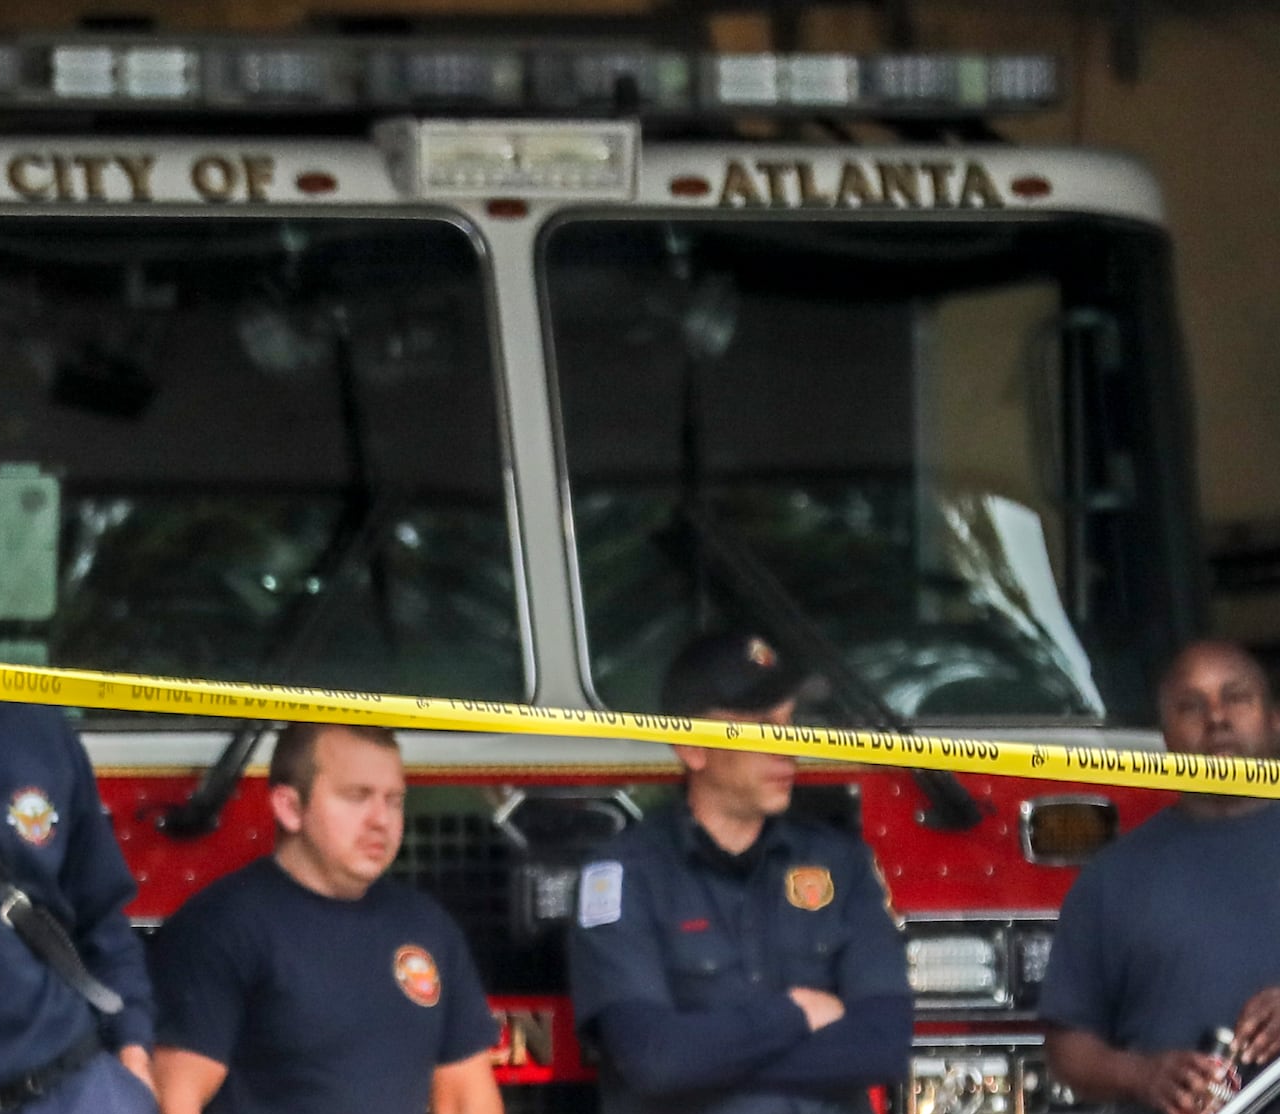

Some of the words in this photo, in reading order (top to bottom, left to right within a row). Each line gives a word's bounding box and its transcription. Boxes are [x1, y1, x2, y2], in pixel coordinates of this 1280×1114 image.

[6, 154, 155, 203] CITY
[191, 155, 274, 203] OF
[718, 159, 1006, 208] ATLANTA
[1065, 746, 1126, 770] POLICE
[1132, 751, 1169, 776] LINE
[1175, 754, 1198, 778] DO
[1204, 756, 1238, 781] NOT
